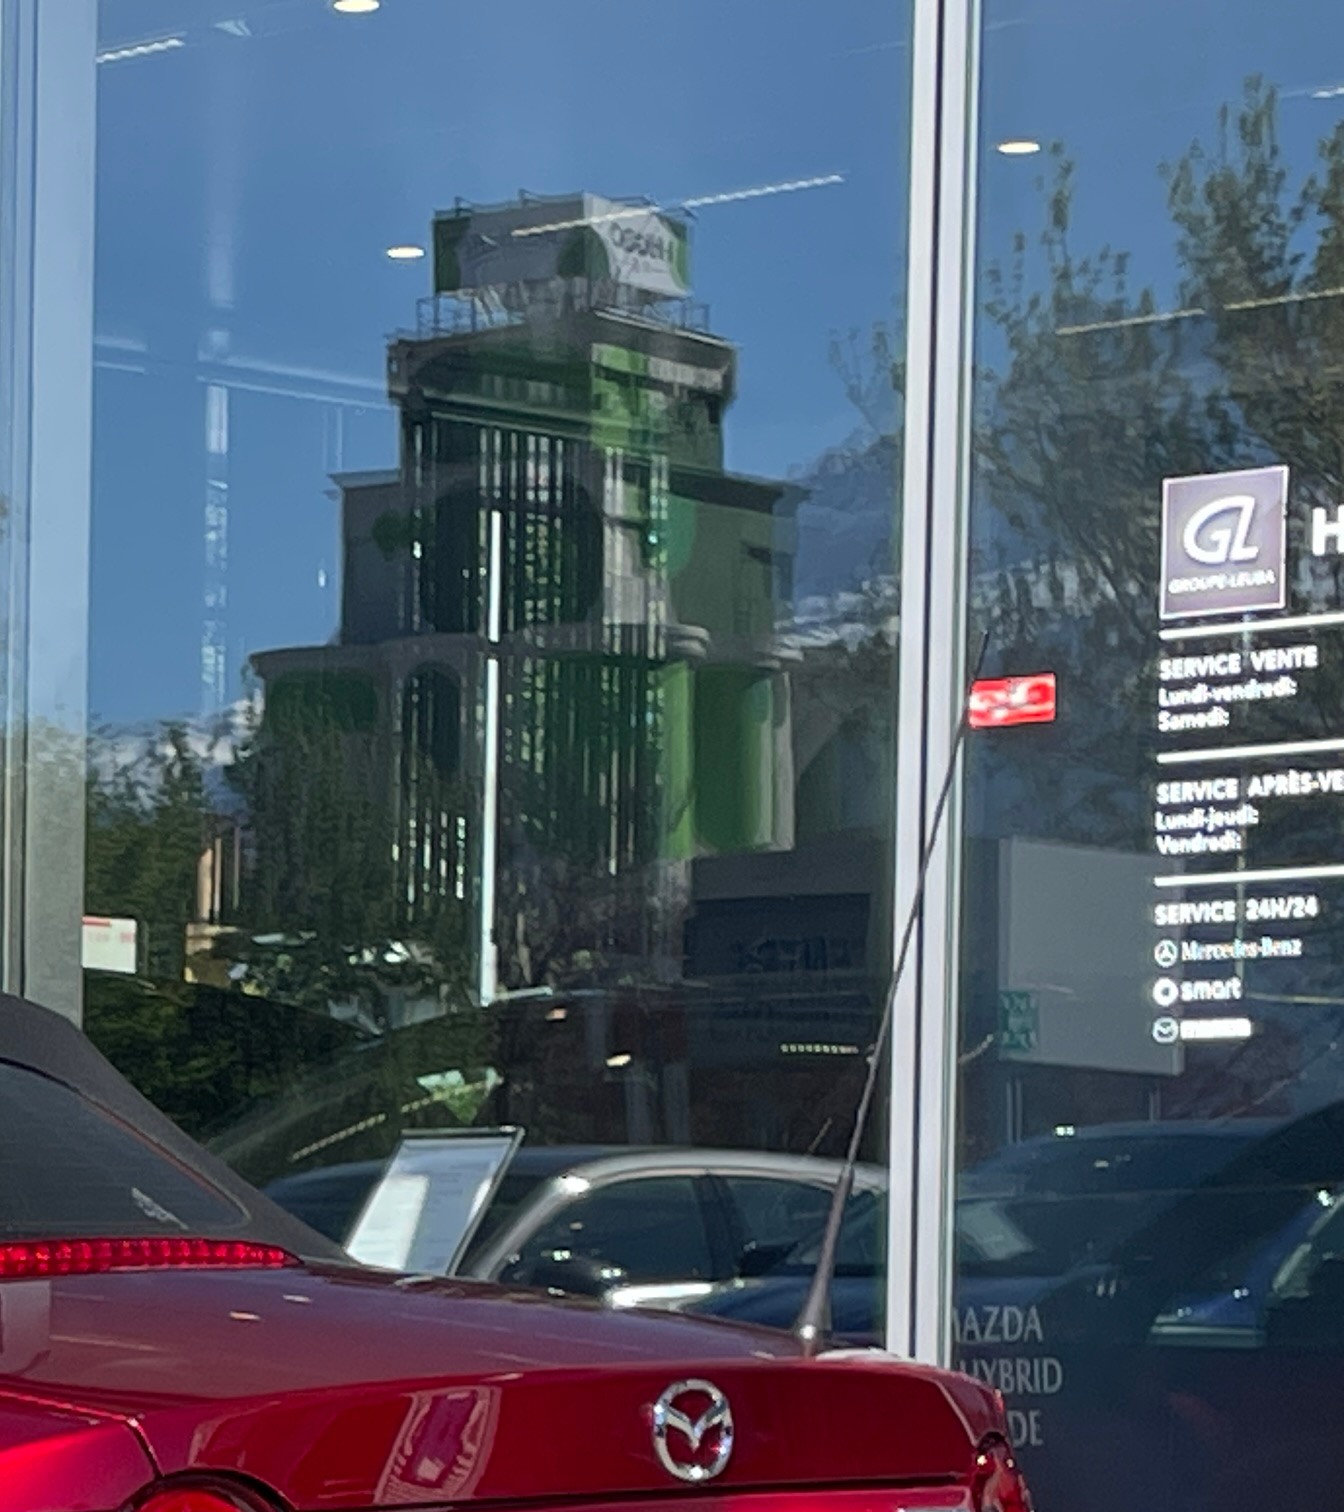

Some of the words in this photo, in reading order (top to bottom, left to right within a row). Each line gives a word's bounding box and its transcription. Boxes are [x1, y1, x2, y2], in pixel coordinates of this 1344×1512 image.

[1158, 652, 1242, 682] SERVICE
[1250, 644, 1319, 673] VENTE
[1156, 777, 1239, 805] SERVICE
[1154, 900, 1237, 926] SERVICE
[1245, 895, 1319, 920] 24H/24
[1181, 935, 1303, 961] Mercedes-Benz
[1180, 977, 1242, 1001] smart
